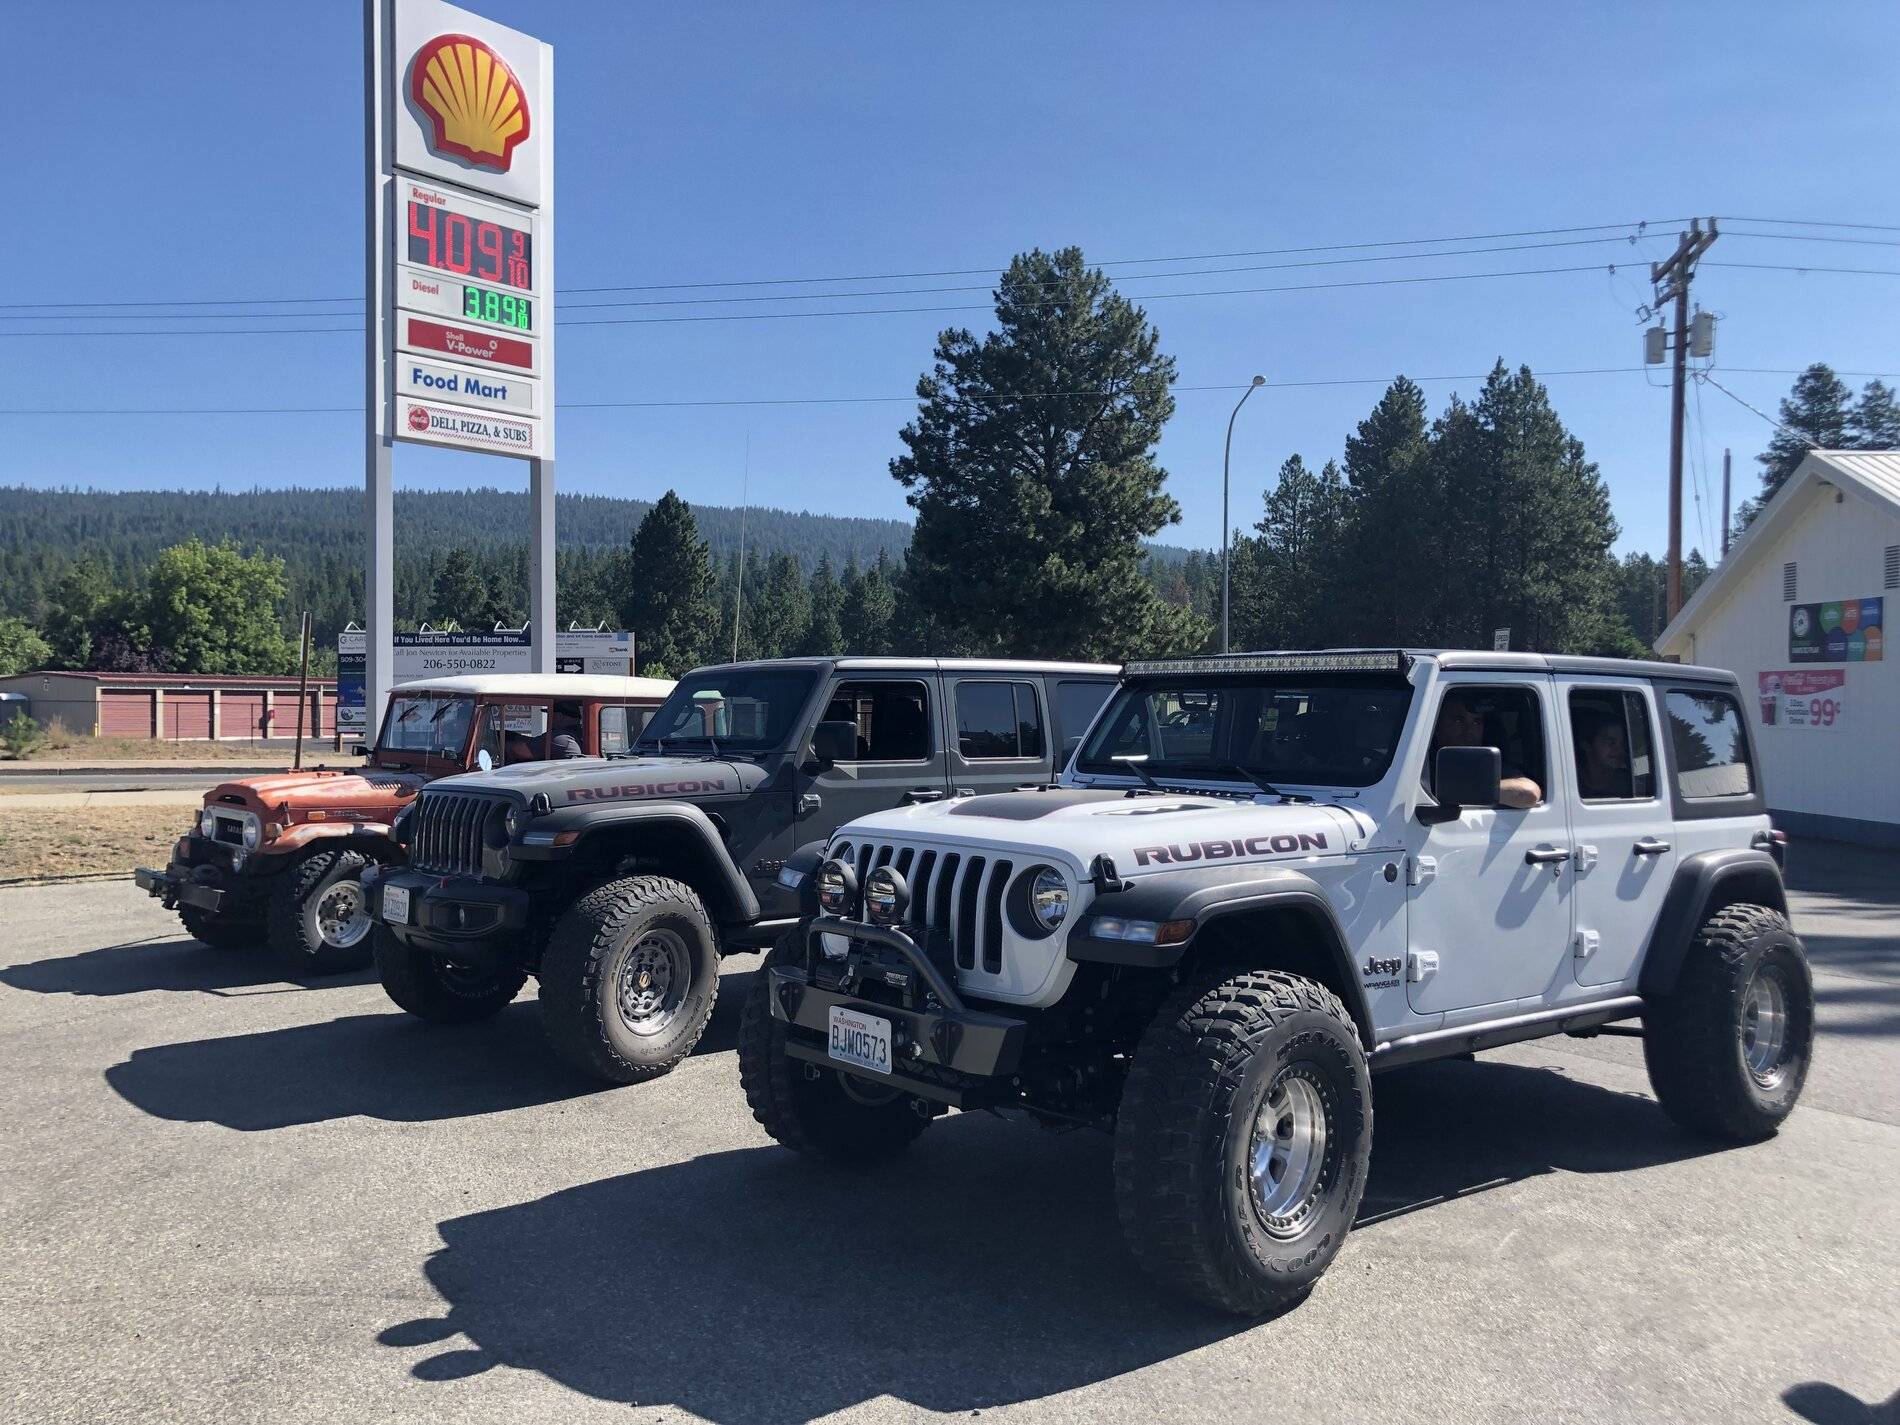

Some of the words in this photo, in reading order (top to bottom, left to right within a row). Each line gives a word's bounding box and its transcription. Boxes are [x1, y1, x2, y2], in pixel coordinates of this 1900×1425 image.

[412, 188, 447, 206] Regular
[412, 280, 440, 295] Diesel
[446, 331, 465, 342] Shell
[446, 339, 494, 359] V-Power
[412, 367, 459, 393] Food
[464, 376, 508, 401] Mart
[431, 415, 459, 433] DELI,
[460, 420, 491, 438] PIZZA,
[493, 426, 501, 438] &
[503, 427, 528, 442] SUBS
[401, 636, 414, 644] You
[415, 635, 434, 644] Lived
[434, 636, 450, 644] Here
[452, 636, 472, 644] You'd
[472, 636, 481, 644] Be
[482, 636, 502, 644] Home
[393, 649, 405, 657] all
[459, 648, 491, 657] Available
[492, 648, 527, 658] Properties
[423, 659, 496, 669] 206-550-0822
[566, 779, 725, 801] RUBICON
[1132, 832, 1329, 867] RUBICON
[1362, 955, 1402, 977] Jeep
[1363, 979, 1401, 989] WRANGLER
[832, 1015, 867, 1031] WASHINGTON
